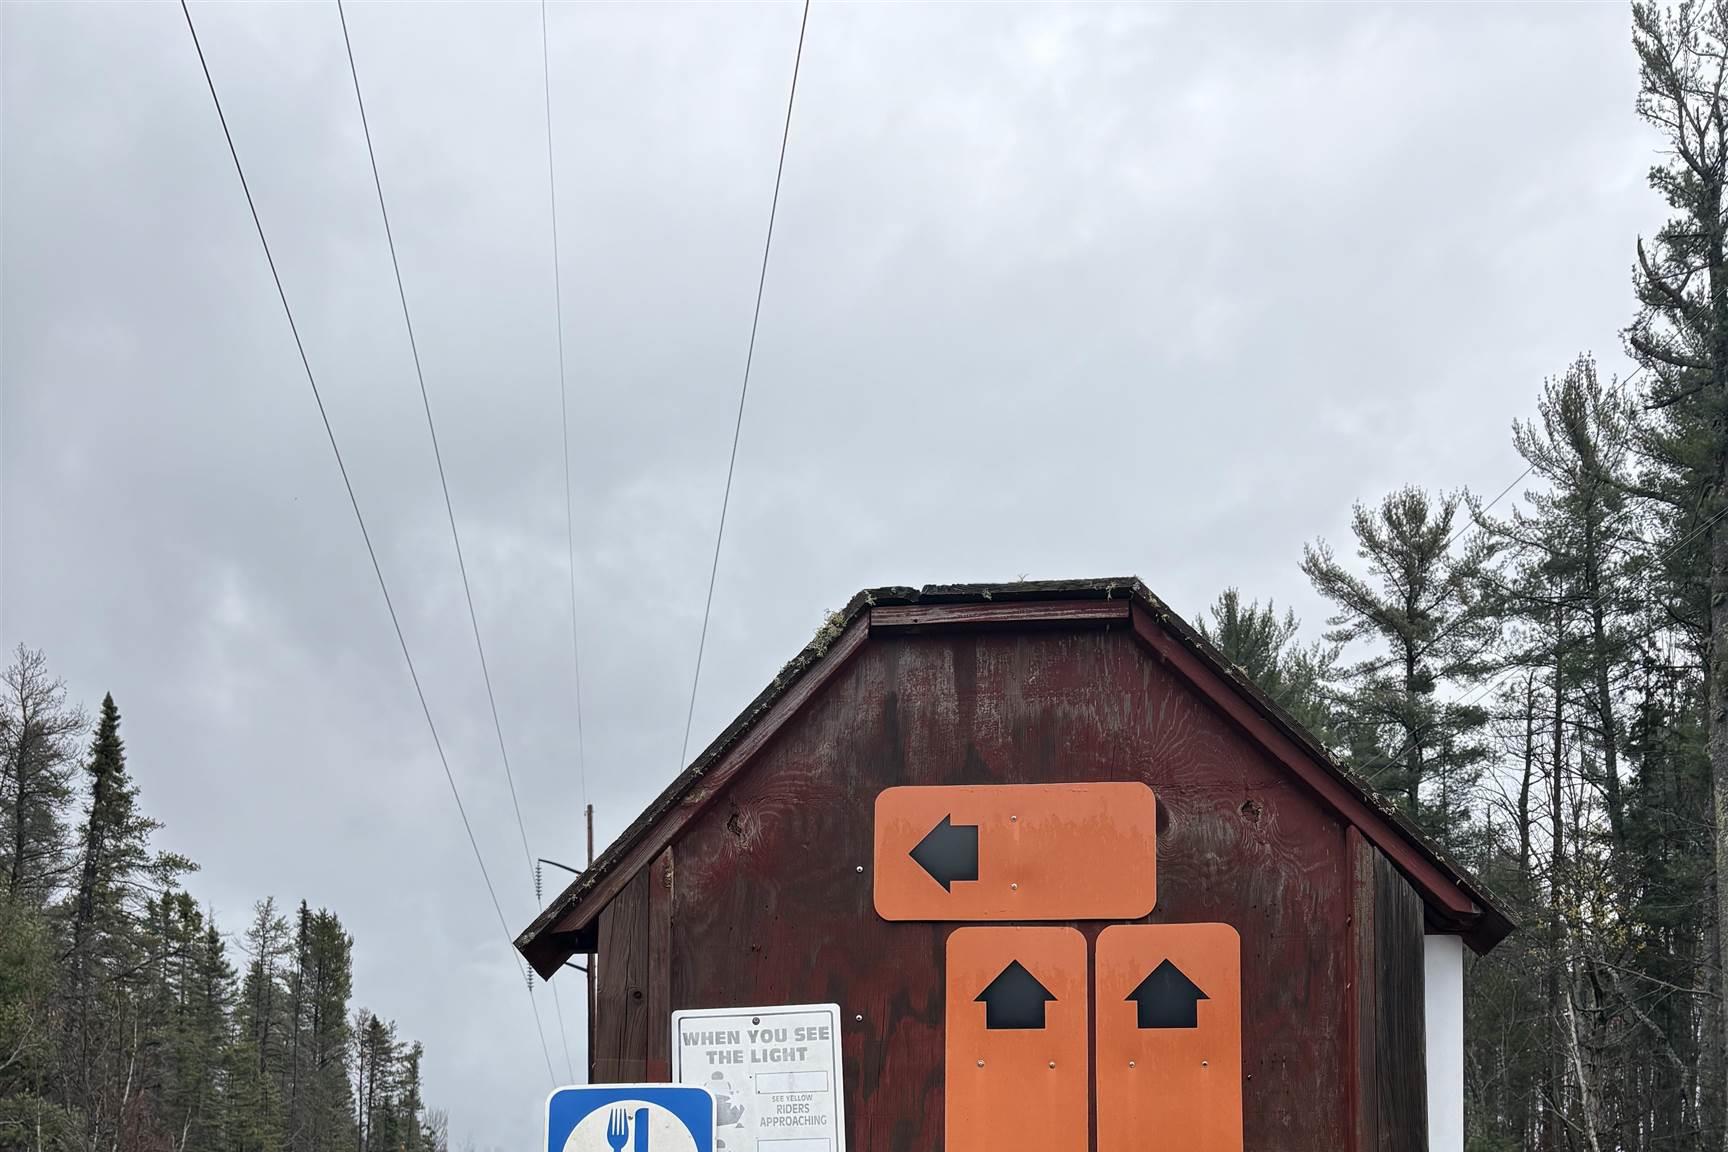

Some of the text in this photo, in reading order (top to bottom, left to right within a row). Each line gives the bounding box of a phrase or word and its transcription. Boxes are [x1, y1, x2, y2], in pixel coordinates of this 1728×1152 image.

[683, 1026, 829, 1046] WHEN YOU SEE
[706, 1047, 808, 1064] THE LIGHT
[776, 1103, 810, 1114] RIDERS
[760, 1115, 827, 1127] APPROACHING
